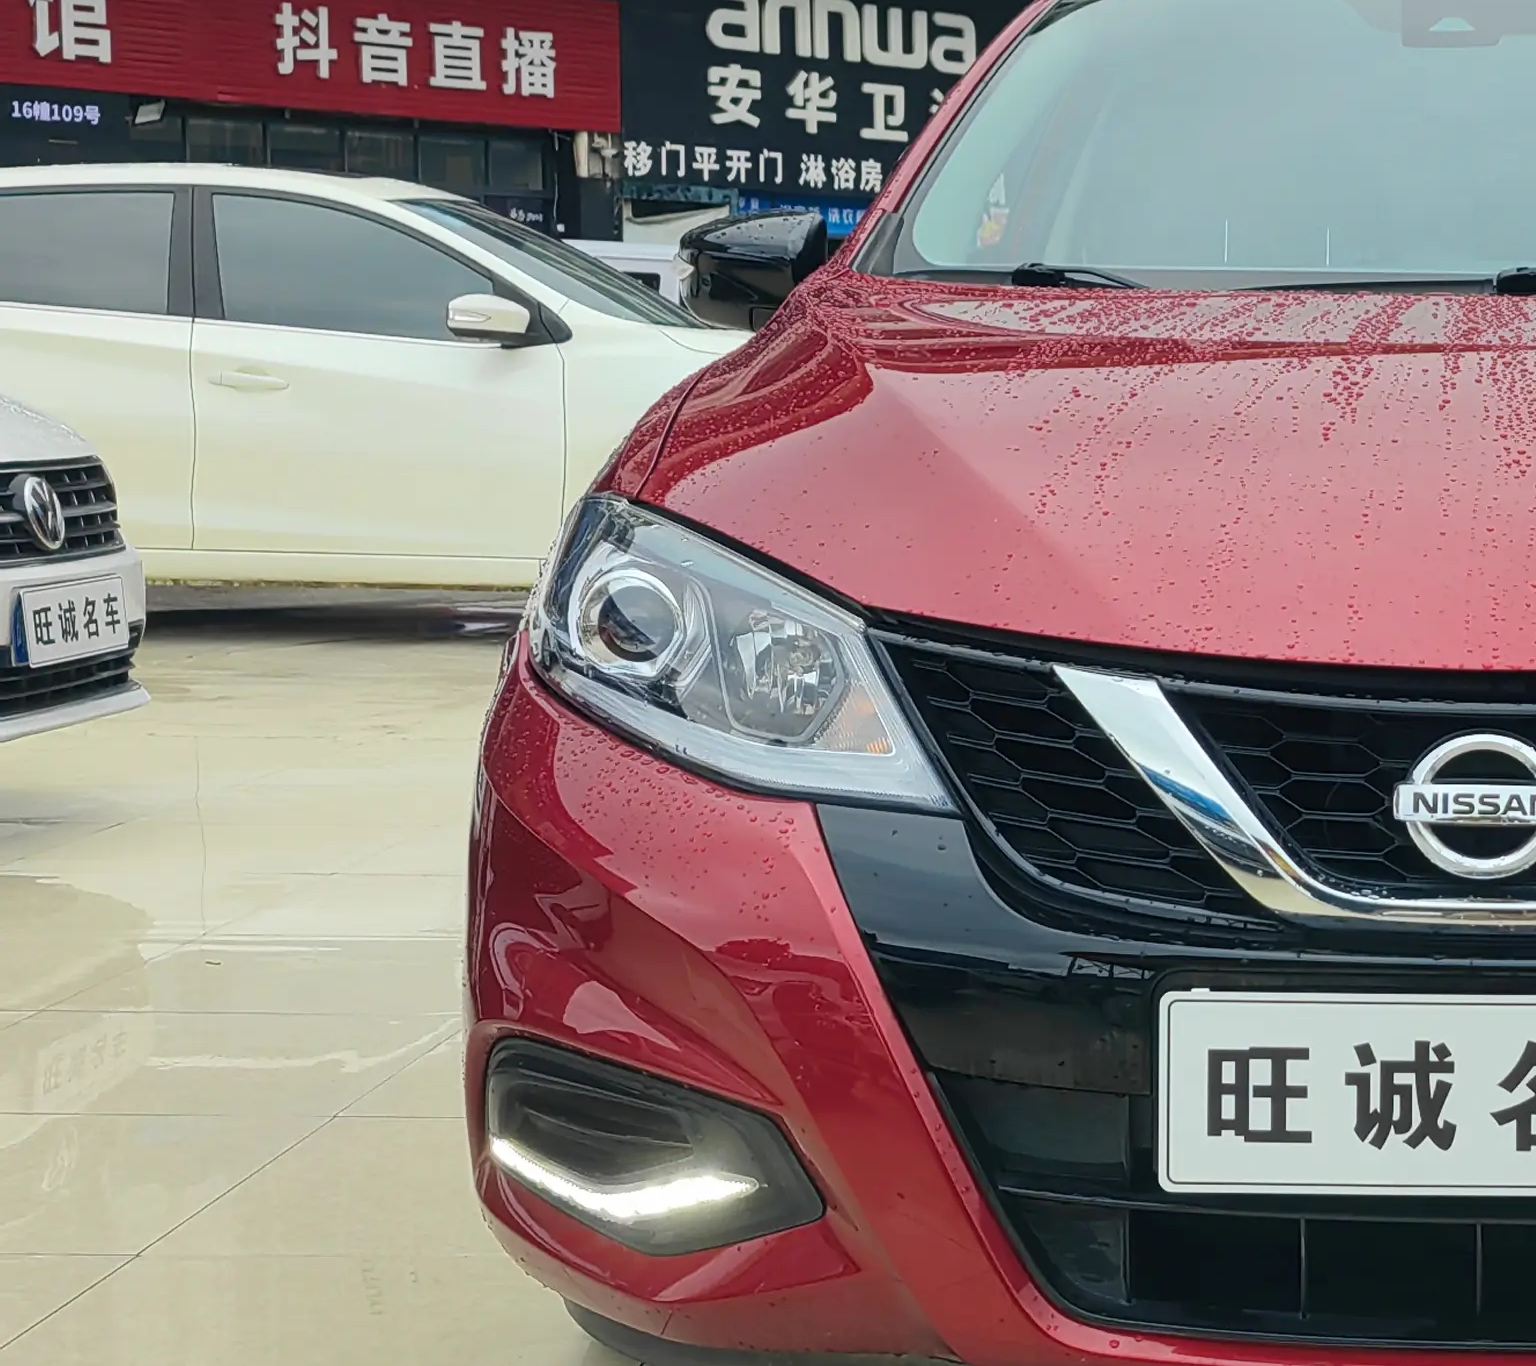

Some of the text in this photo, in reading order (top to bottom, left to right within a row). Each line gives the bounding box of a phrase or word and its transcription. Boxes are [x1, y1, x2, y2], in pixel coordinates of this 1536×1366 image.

[274, 1, 558, 99] 抖音直播
[706, 64, 949, 143] 安华卫
[623, 140, 884, 194] 移门平开门 淋浴房
[32, 593, 121, 647] 旺诚名车
